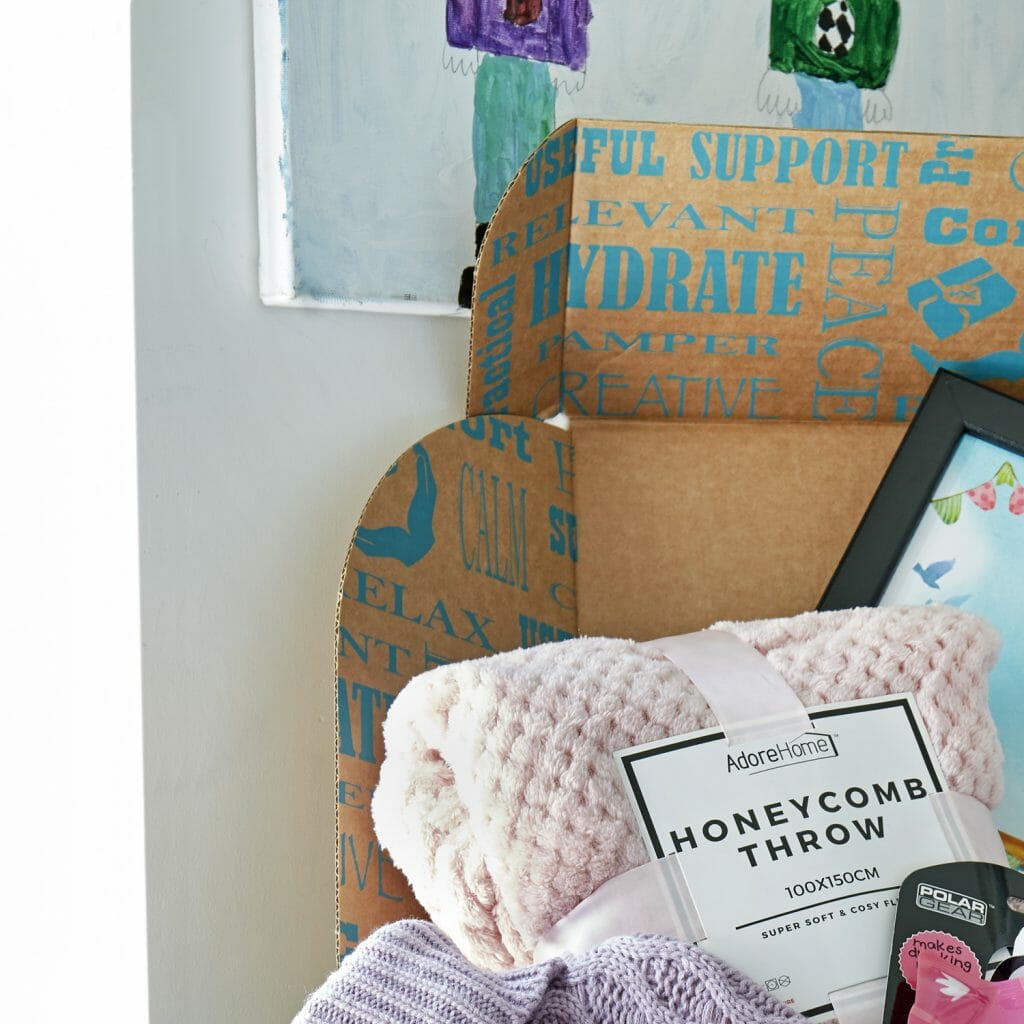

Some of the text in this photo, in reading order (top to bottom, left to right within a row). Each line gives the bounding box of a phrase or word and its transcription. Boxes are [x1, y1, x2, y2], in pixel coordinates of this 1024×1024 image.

[525, 127, 665, 198] USEFUL
[689, 131, 909, 188] SUPPORT
[491, 200, 815, 267] RELEVANT
[530, 243, 806, 328] HYDRATE
[812, 197, 901, 421] PEACE
[536, 331, 779, 363] PAMPER
[531, 371, 795, 421] CREATIVE
[458, 461, 529, 592] CALM
[342, 568, 500, 654] ELAX
[726, 735, 830, 774] AdoreHome
[669, 778, 928, 853] HONEYCOMB
[738, 816, 885, 868] THROW
[784, 866, 880, 900] 100X150CM
[920, 885, 985, 913] POLAR
[761, 921, 801, 939] SUPER
[804, 911, 835, 928] SOFT
[839, 909, 847, 917] &
[850, 901, 880, 915] COSY
[920, 896, 984, 924] GEAR
[913, 938, 962, 955] makes
